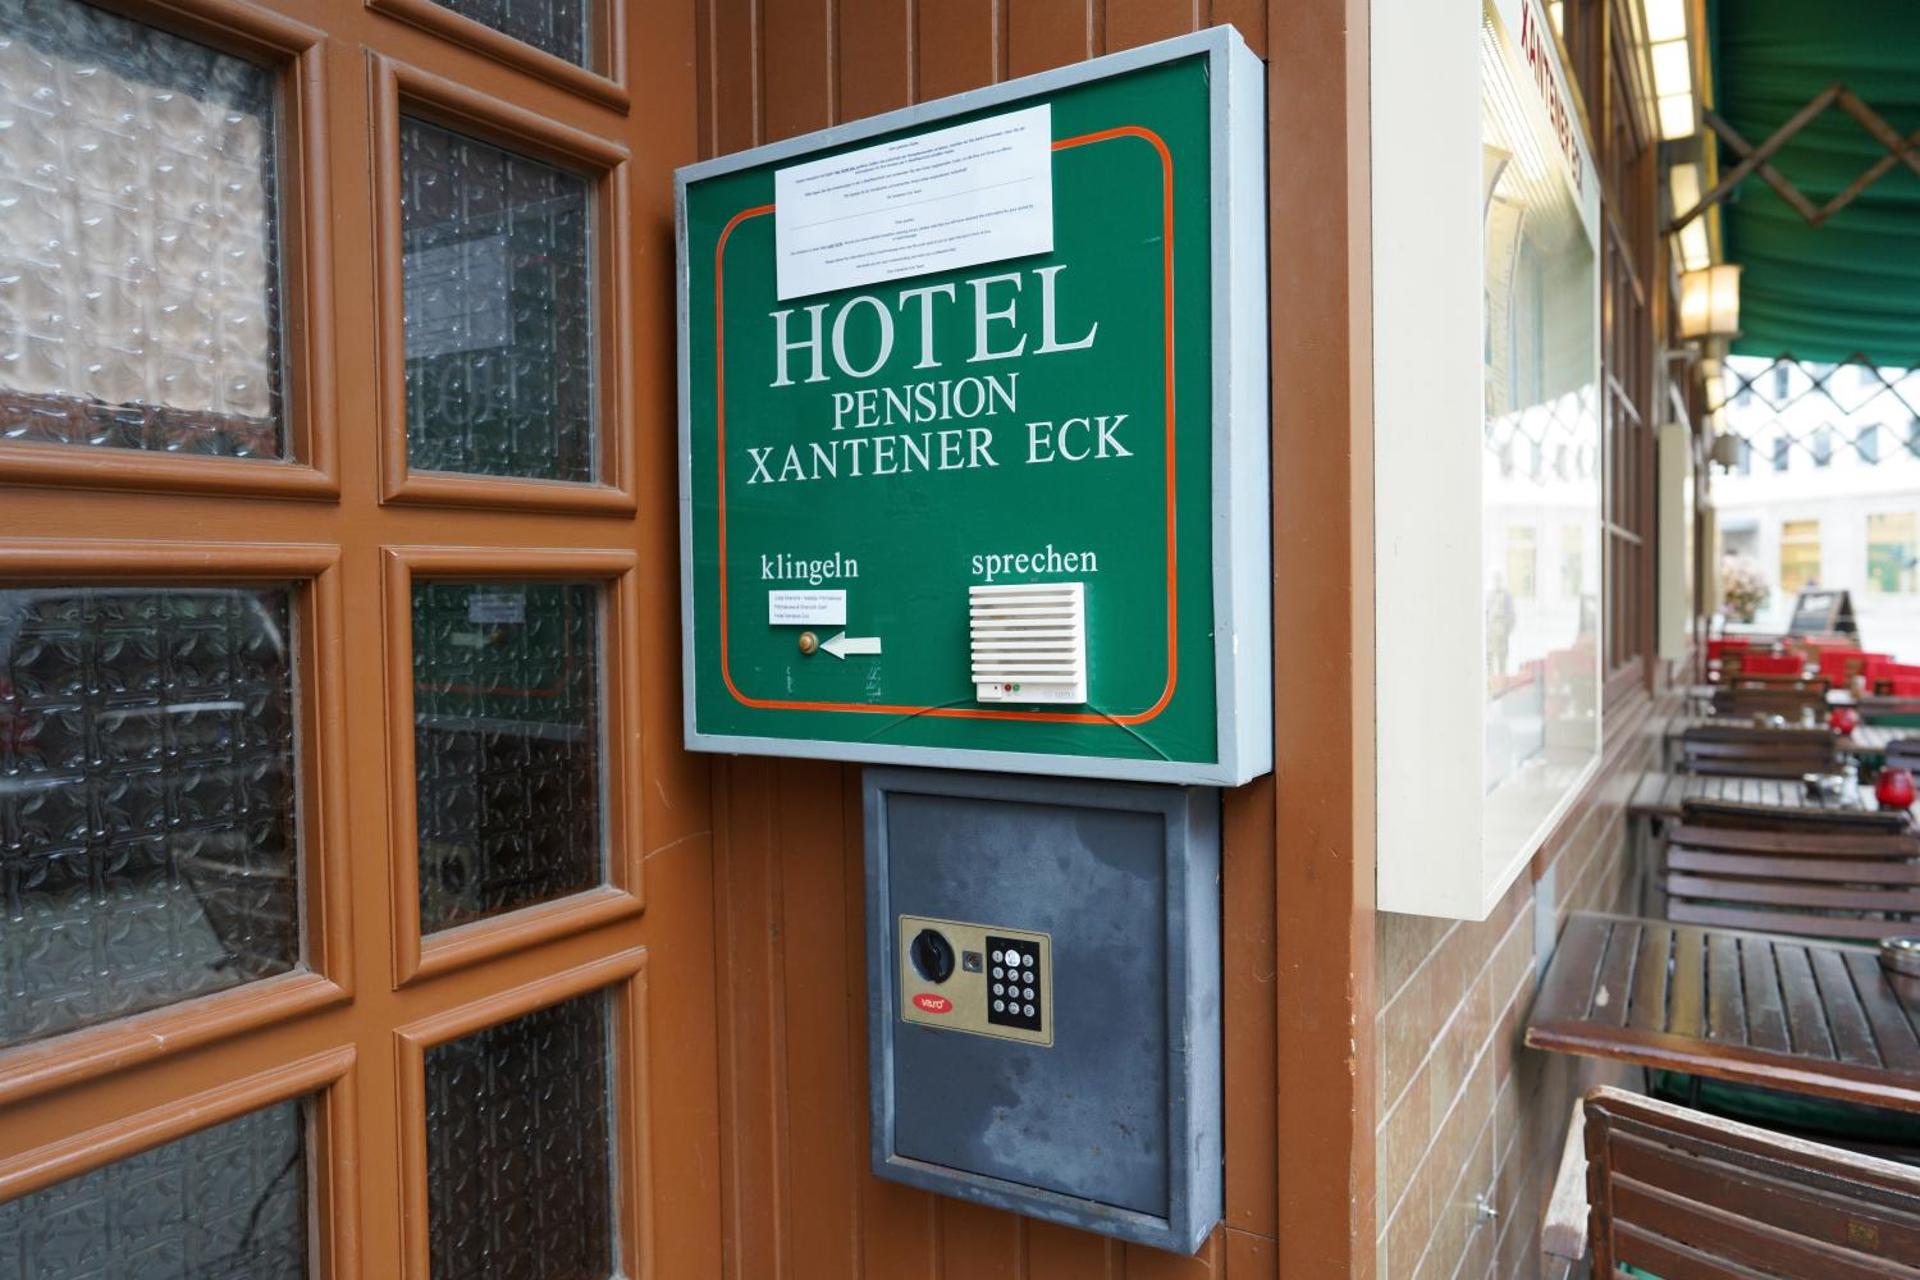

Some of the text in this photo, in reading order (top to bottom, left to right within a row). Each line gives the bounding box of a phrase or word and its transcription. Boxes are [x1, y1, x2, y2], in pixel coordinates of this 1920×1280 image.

[769, 264, 1098, 387] HOTEL
[832, 372, 1019, 430] PENSION
[747, 414, 1133, 484] XANTENER ECK
[761, 552, 859, 586] klingeln
[971, 544, 1098, 582] sprechen
